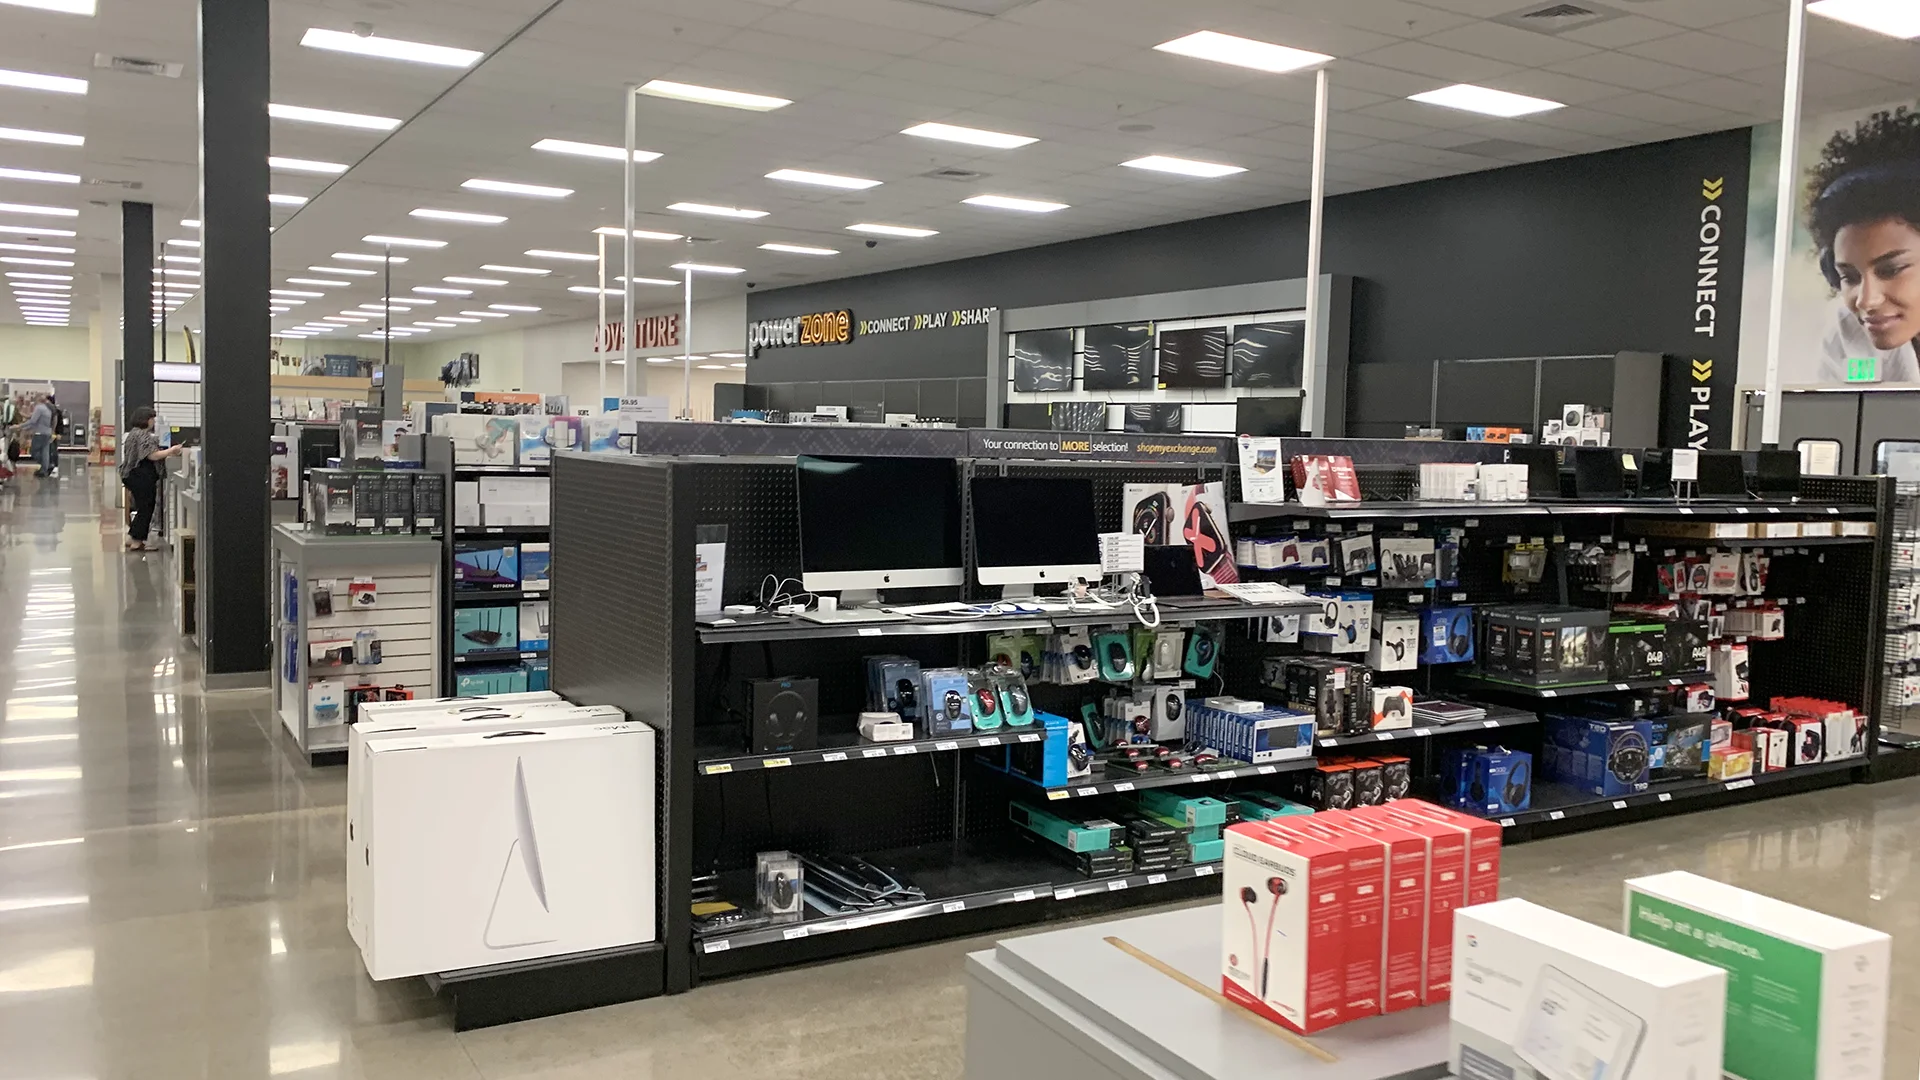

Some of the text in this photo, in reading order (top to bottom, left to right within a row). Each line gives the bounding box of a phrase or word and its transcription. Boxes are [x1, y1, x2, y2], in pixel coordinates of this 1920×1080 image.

[1694, 204, 1722, 337] CONNECT
[593, 314, 679, 352] ADVETURE
[748, 310, 850, 357] powerzone
[867, 307, 998, 334] CONNECT PLAY SHAR
[1848, 358, 1876, 380] EXIT
[1688, 386, 1711, 450] PLAY
[983, 438, 1217, 456] Your connection to MORE selection! shopmyexchange.com
[1638, 904, 1674, 931] Help
[1674, 920, 1692, 937] at
[1692, 927, 1705, 941] a
